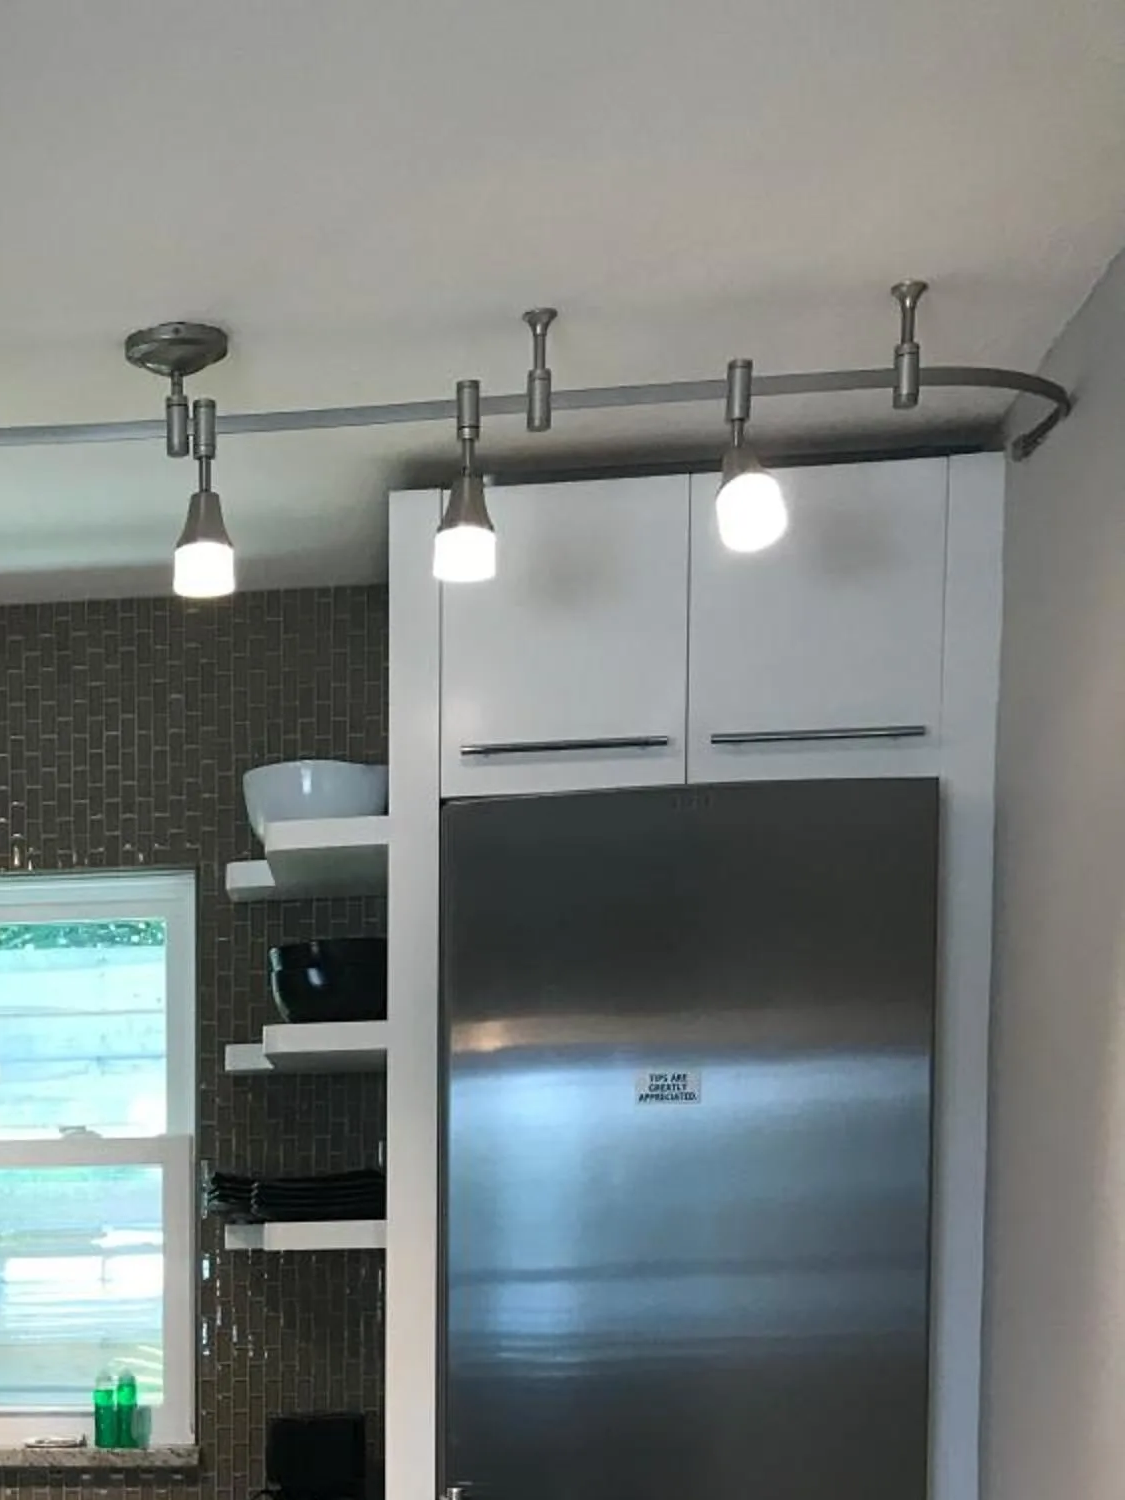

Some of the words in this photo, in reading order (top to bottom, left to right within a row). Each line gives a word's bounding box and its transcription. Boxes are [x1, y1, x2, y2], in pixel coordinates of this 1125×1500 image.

[649, 1073, 668, 1082] TIPS
[670, 1073, 687, 1082] ARE
[648, 1083, 687, 1092] GREATLY
